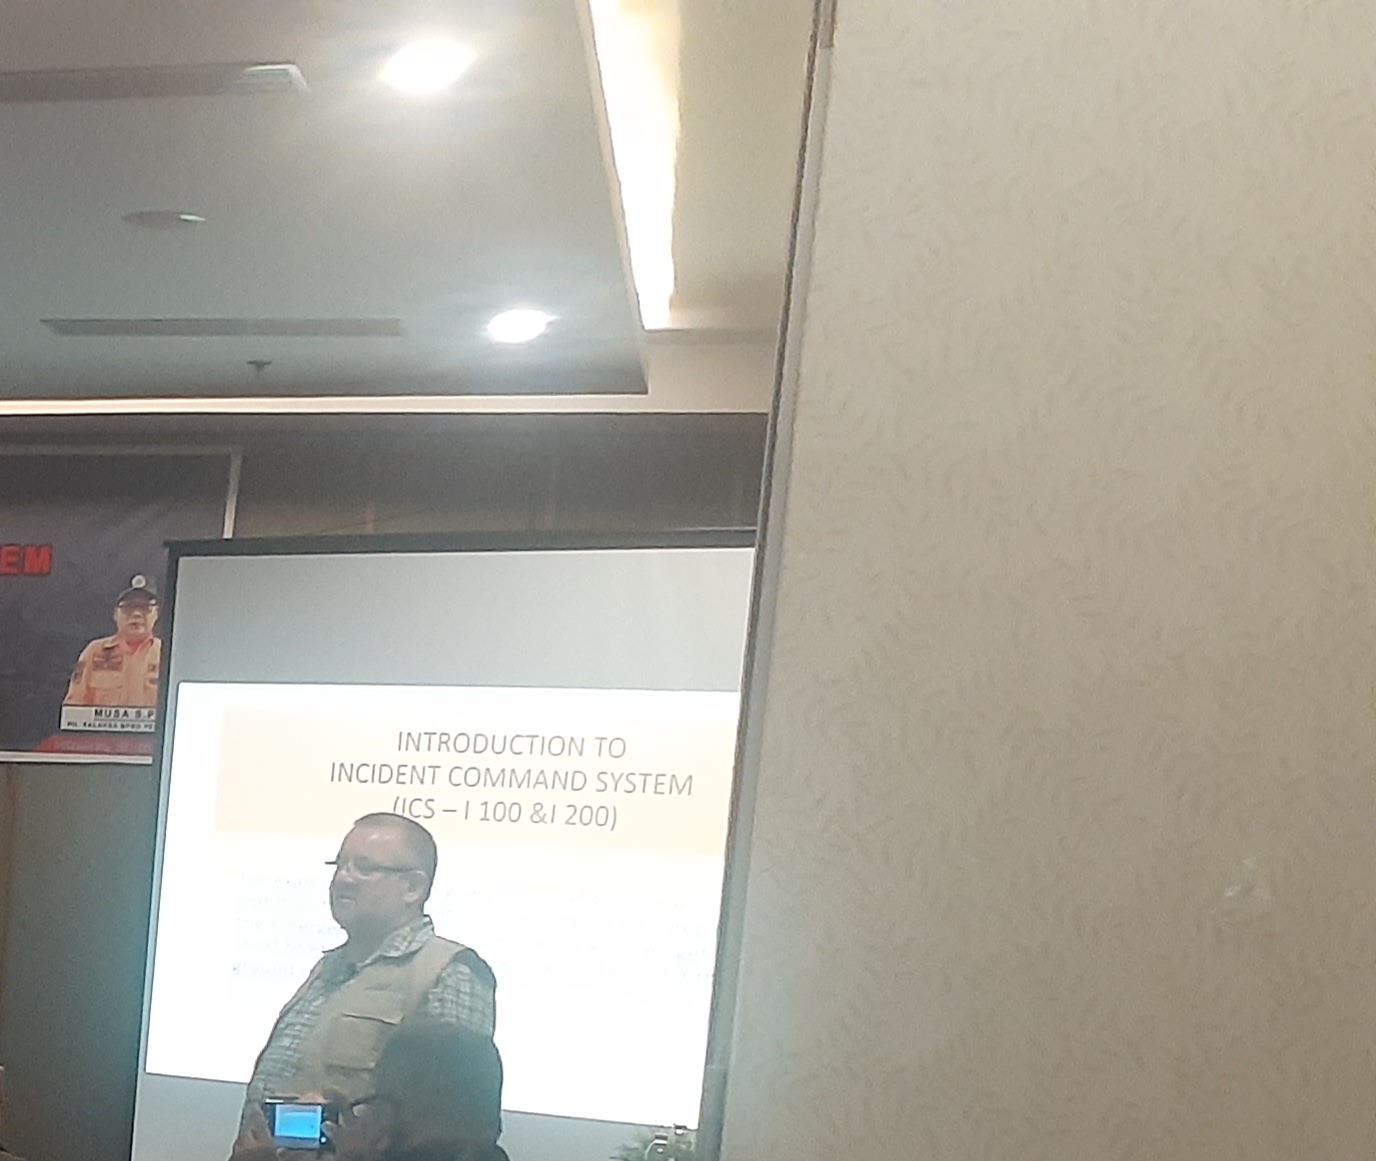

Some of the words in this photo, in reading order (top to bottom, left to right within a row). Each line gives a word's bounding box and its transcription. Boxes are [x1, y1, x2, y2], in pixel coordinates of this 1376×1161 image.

[94, 708, 130, 718] MUSA
[397, 731, 585, 757] INTRODUCTION
[594, 736, 627, 759] TO
[329, 761, 441, 786] INCIDENT
[447, 765, 588, 792] COMMAND
[594, 771, 694, 796] SYSTEM
[393, 796, 436, 820] (ICS
[479, 800, 522, 824] 100
[529, 803, 557, 825] &I
[564, 804, 618, 832] 200)
